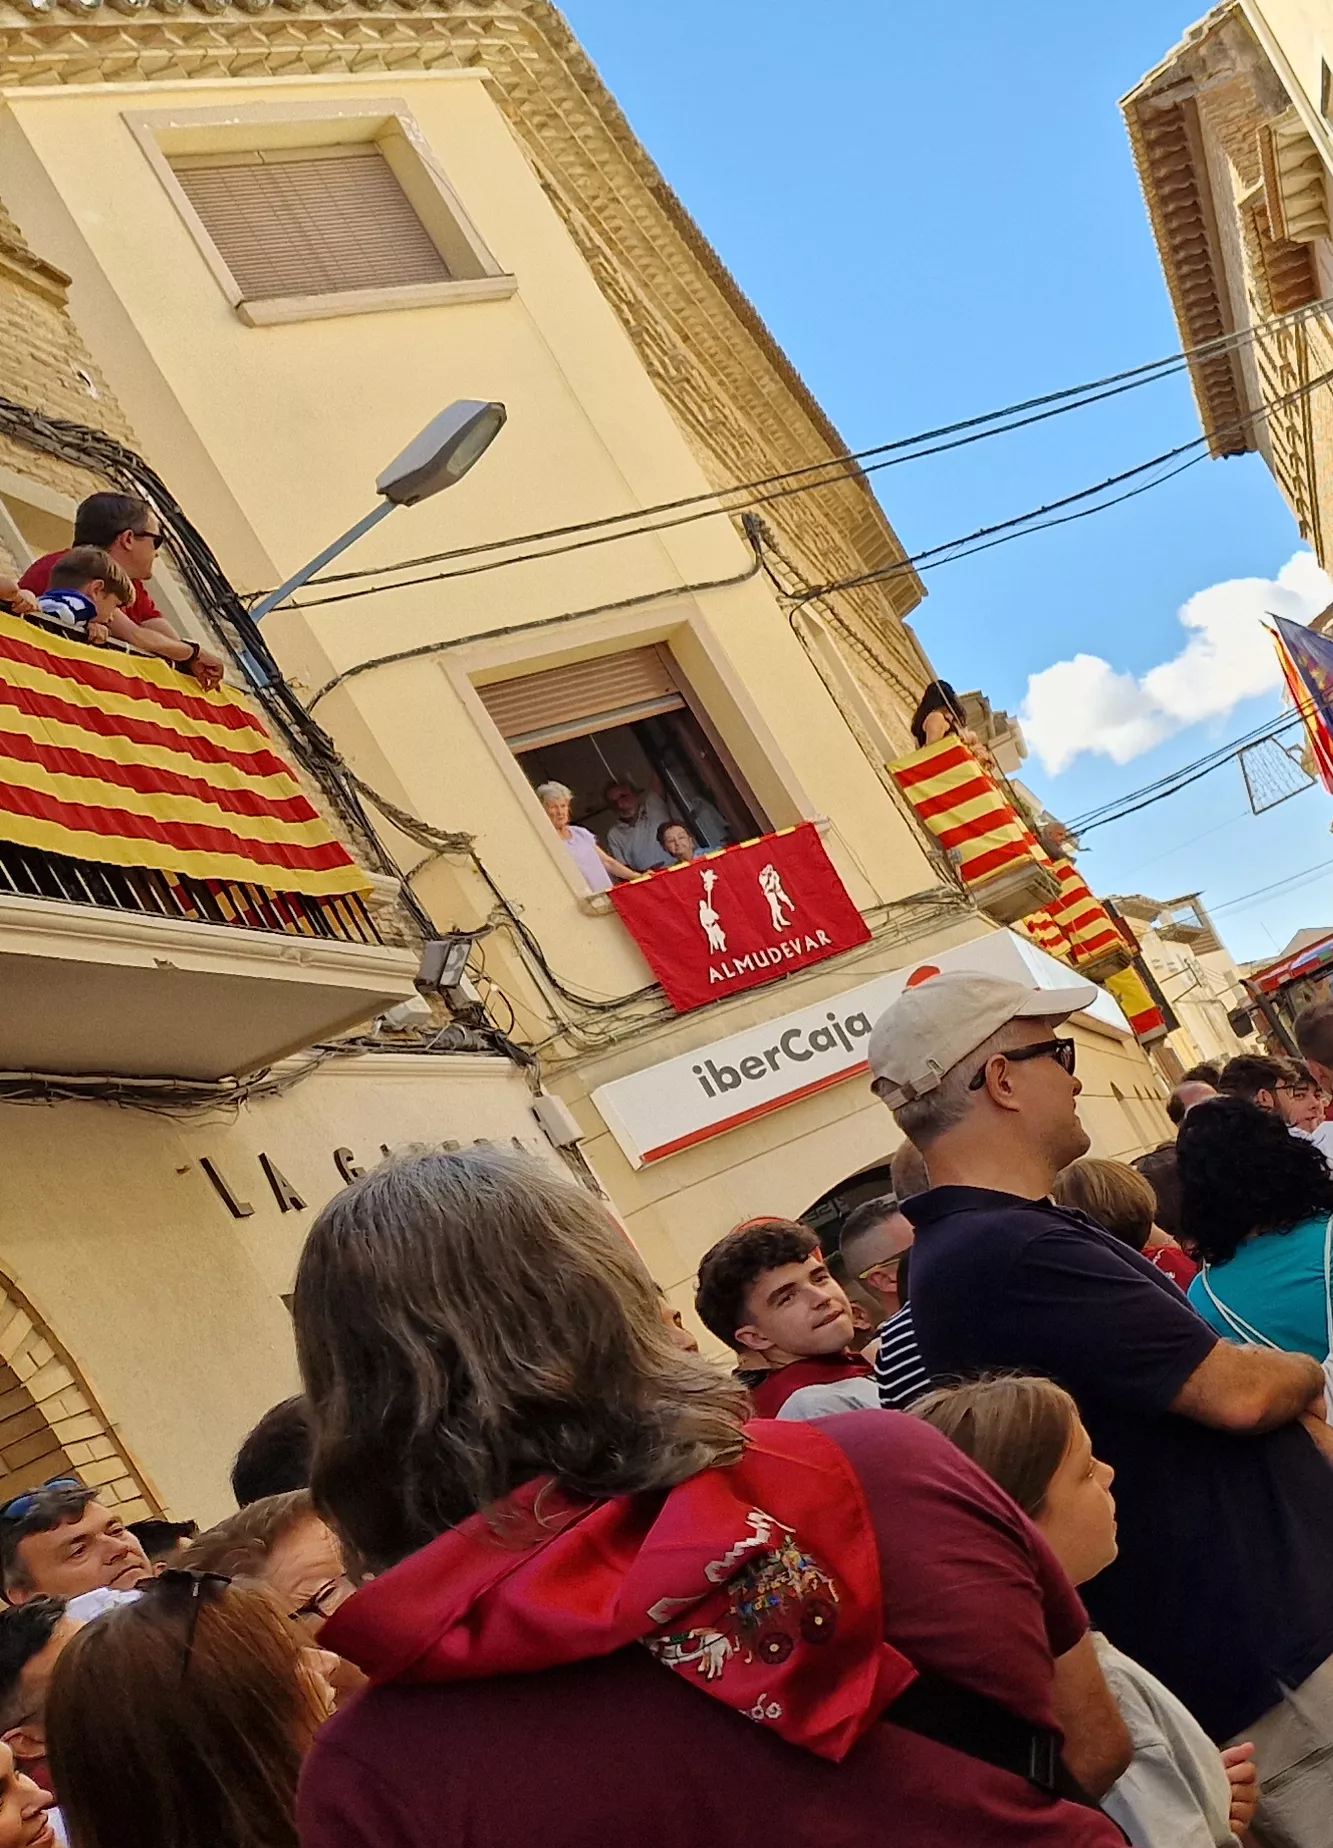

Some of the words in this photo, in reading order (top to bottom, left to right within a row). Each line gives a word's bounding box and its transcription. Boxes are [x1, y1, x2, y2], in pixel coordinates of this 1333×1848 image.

[708, 930, 832, 984] ALMUDEVAR
[692, 1012, 873, 1098] iberCaja
[199, 1152, 309, 1218] LA
